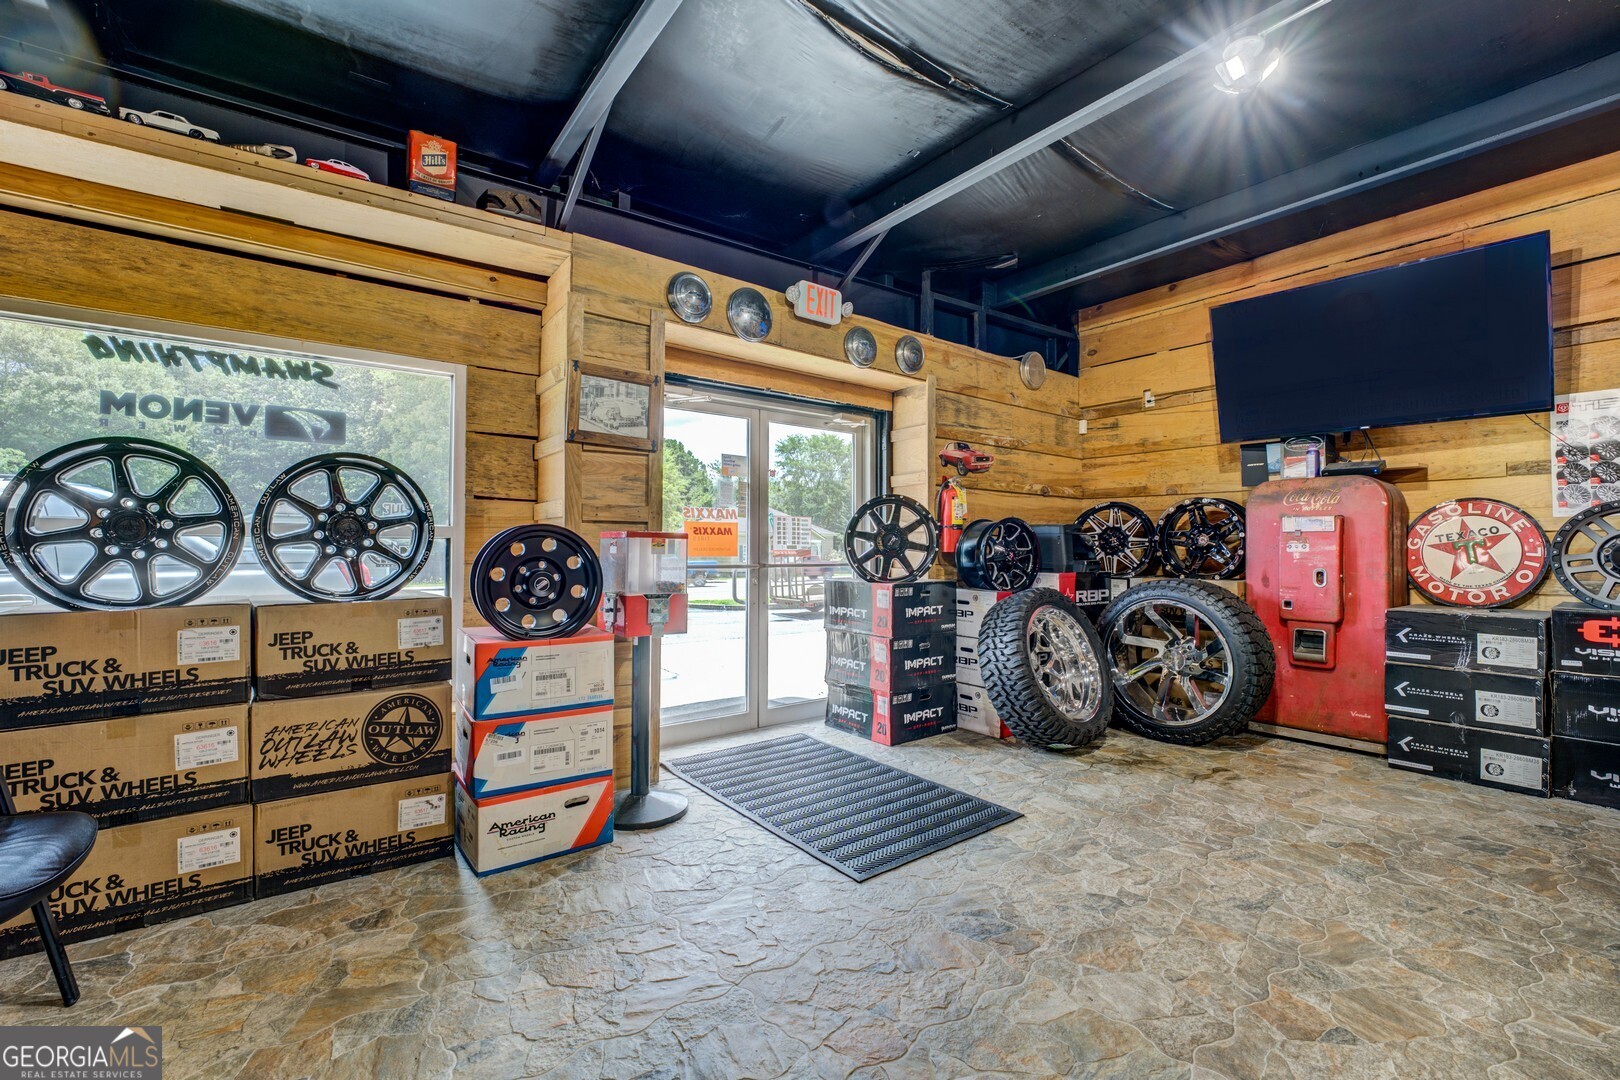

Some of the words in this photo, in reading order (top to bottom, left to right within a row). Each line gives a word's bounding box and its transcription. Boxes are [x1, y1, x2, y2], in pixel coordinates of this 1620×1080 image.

[422, 155, 446, 166] Hill's
[806, 284, 836, 320] EXIT
[260, 473, 286, 505] OUTLAW
[226, 493, 240, 540] AMERICAN
[423, 500, 434, 541] AMERICAN
[1407, 502, 1531, 550] GASOLINE
[254, 516, 268, 561] AMERICAN
[1435, 525, 1500, 542] TEXACO
[1454, 538, 1484, 564] T
[206, 551, 235, 586] OUTLAW
[408, 550, 430, 581] OUTLAW
[1515, 547, 1542, 584] OIL
[1411, 565, 1511, 604] MOTOR
[1076, 589, 1110, 602] RBP
[829, 606, 868, 619] IMPACT
[905, 605, 944, 618] IMPACT
[956, 610, 974, 618] BP
[876, 616, 887, 628] 20
[268, 631, 314, 647] JEEP
[279, 642, 342, 660] TRUCK
[346, 642, 359, 655] &
[302, 658, 340, 672] SUV
[345, 650, 414, 669] WHEELS
[486, 656, 528, 664] American
[8, 659, 99, 682] TRUCK
[103, 658, 122, 673] &
[831, 656, 866, 672] IMPACT
[904, 656, 944, 670] IMPACT
[42, 677, 96, 697] SUV
[103, 668, 200, 691] WHEELS
[874, 669, 886, 682] 20
[1407, 690, 1444, 698] PERFORMANCE
[380, 698, 434, 716] AMERICAN
[832, 704, 868, 724] IMPACT
[904, 707, 944, 724] IMPACT
[264, 718, 360, 738] AMERICAN
[368, 724, 438, 736] OUTLAW
[876, 722, 886, 736] 20
[260, 729, 358, 754] OUTLAW
[1410, 746, 1448, 755] PERFORMANCE
[1438, 746, 1468, 754] WHEELS
[258, 744, 358, 770] WHEELS
[371, 745, 426, 762] WHEELS
[8, 769, 96, 796] TRUCK
[100, 767, 120, 782] &
[40, 788, 94, 808] SUV
[100, 772, 197, 800] WHEELS
[488, 812, 556, 832] American
[500, 822, 546, 838] Racing
[265, 824, 312, 844] JEEP
[277, 832, 342, 856] TRUCK
[344, 830, 359, 844] &
[301, 847, 340, 866] SUV
[344, 832, 416, 857] WHEELS
[48, 878, 102, 902] UCK
[106, 874, 125, 890] &
[106, 874, 202, 906] WHEELS
